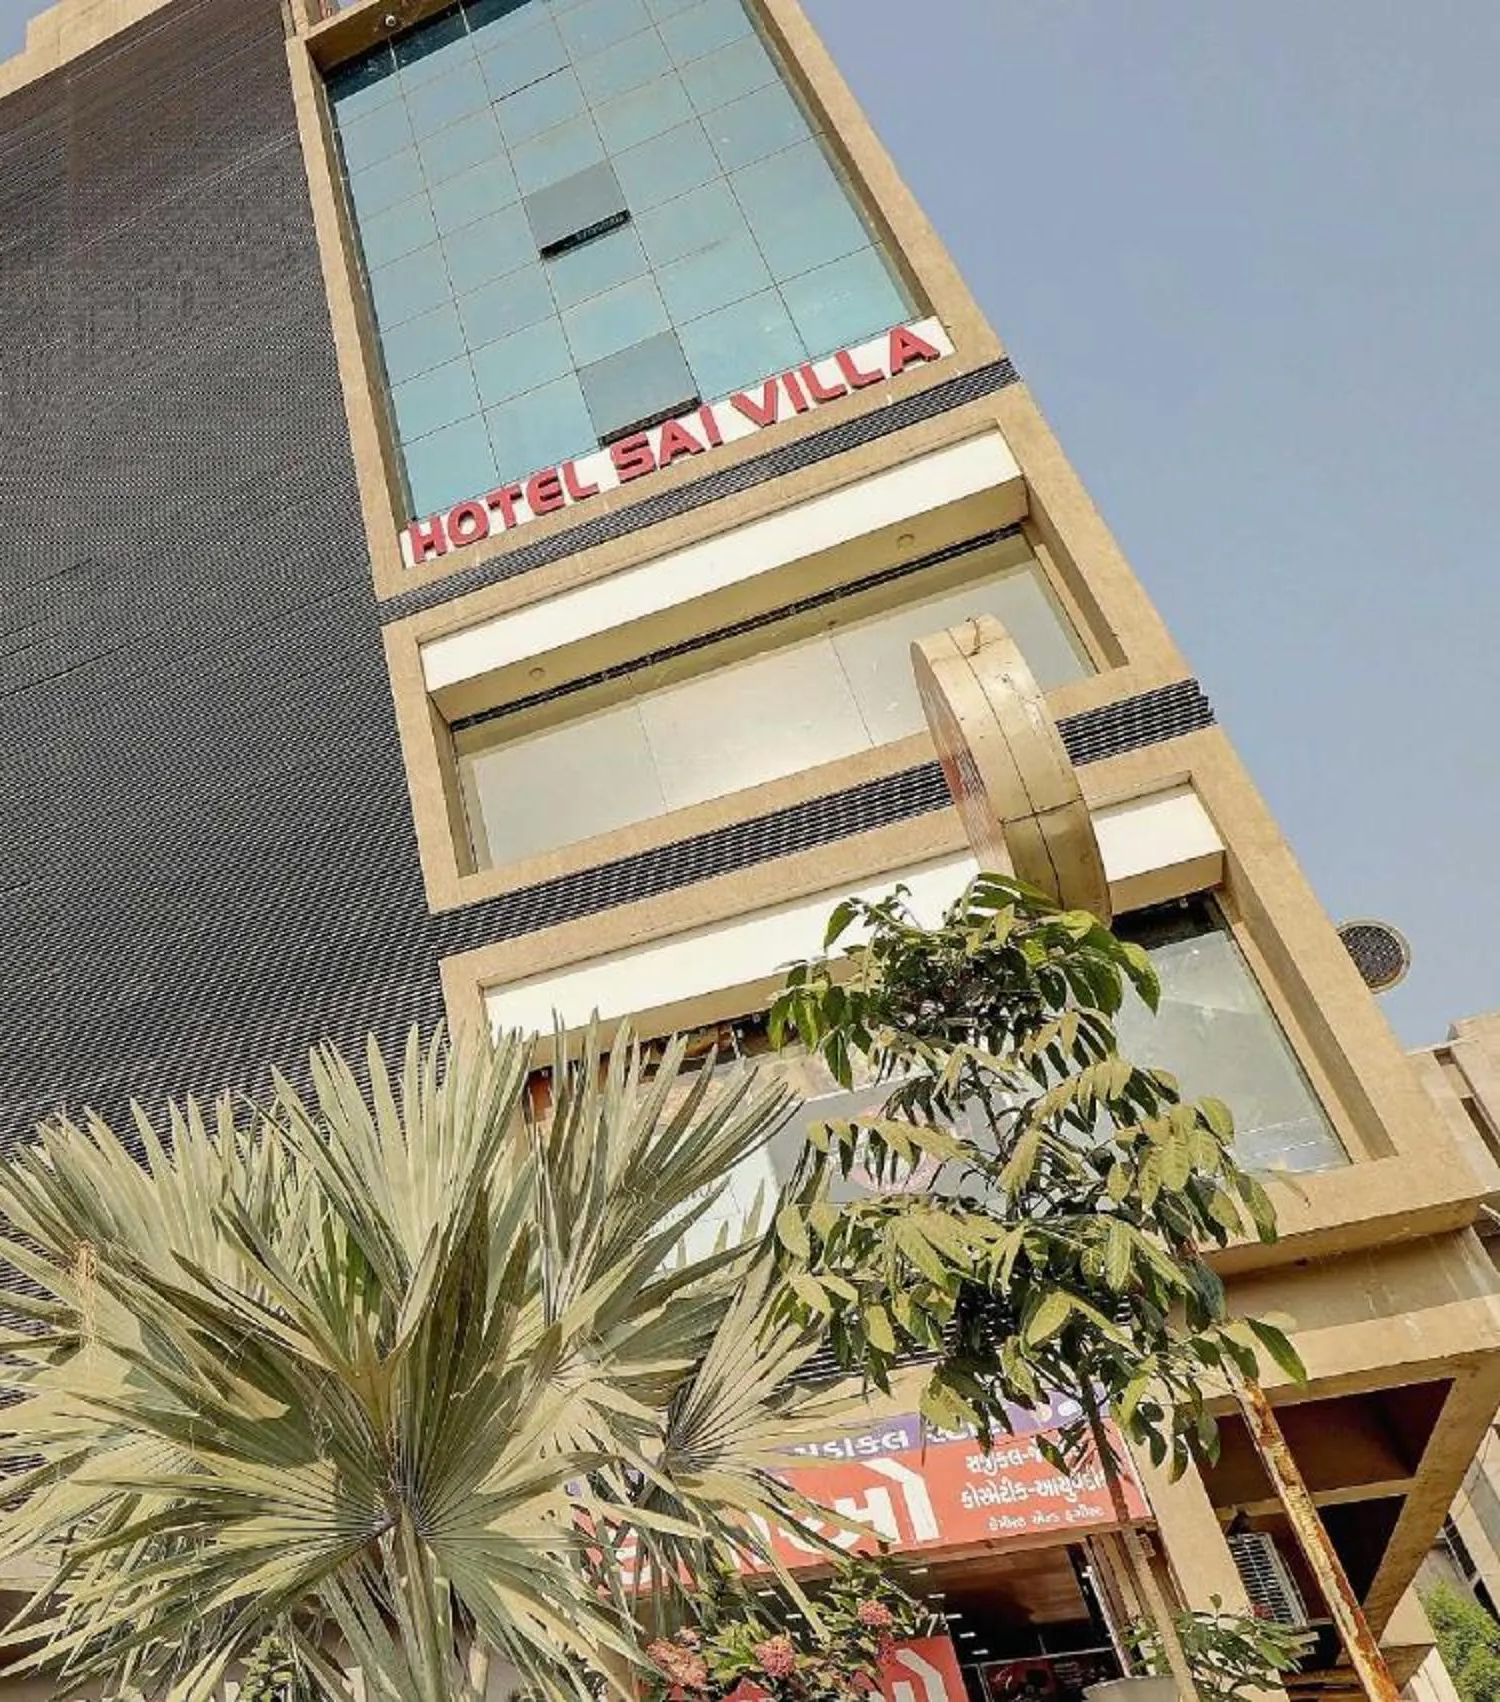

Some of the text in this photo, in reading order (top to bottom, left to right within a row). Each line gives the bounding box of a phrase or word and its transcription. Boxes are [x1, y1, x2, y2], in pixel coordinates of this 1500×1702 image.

[407, 326, 942, 565] HOTEL SAI VILLA
